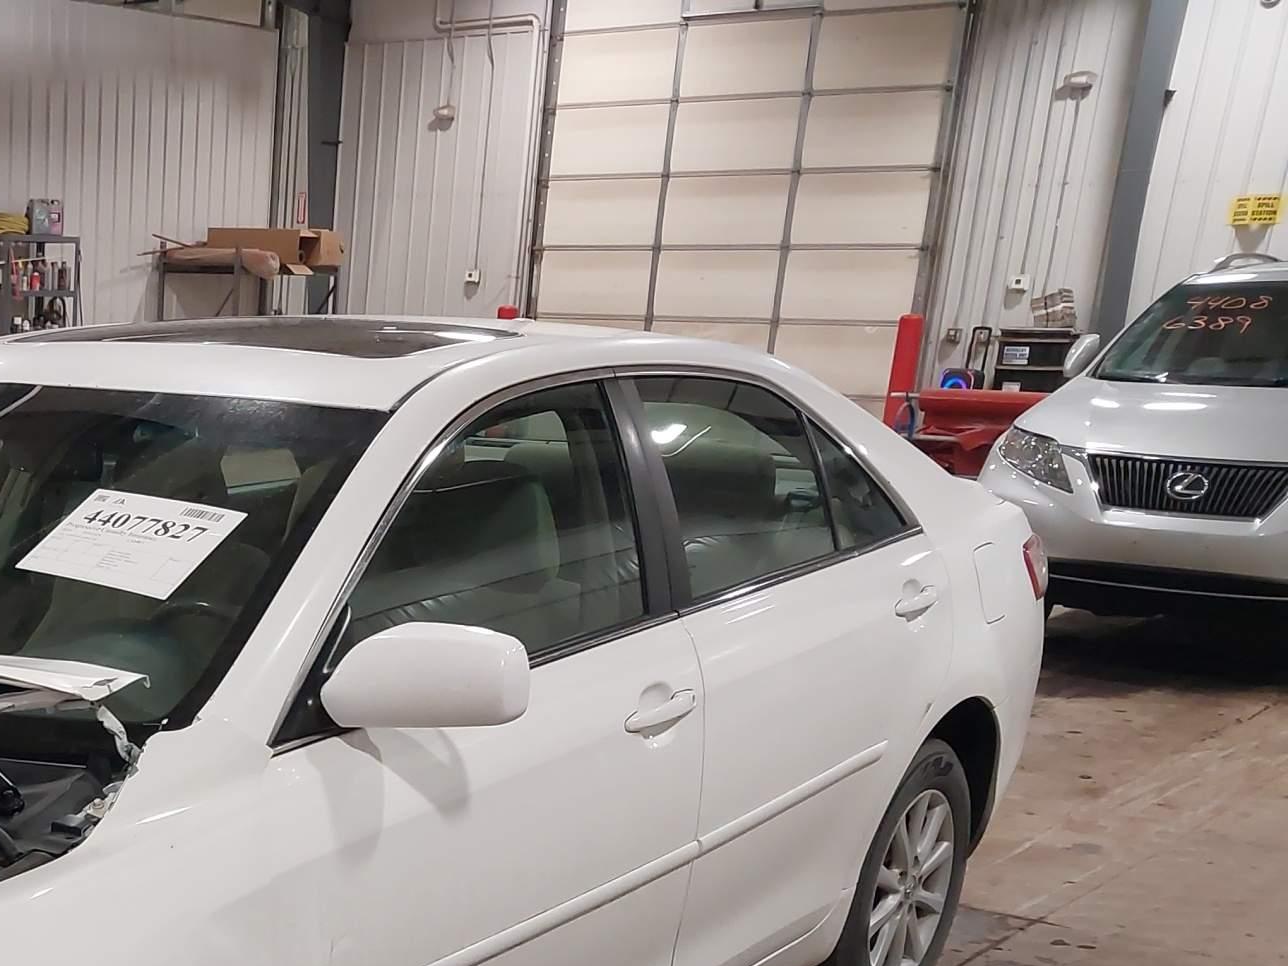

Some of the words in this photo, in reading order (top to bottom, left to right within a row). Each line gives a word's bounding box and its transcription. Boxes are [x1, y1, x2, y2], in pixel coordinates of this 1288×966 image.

[1186, 295, 1273, 310] 4408
[1162, 315, 1252, 334] 6389
[83, 509, 209, 542] 44077827
